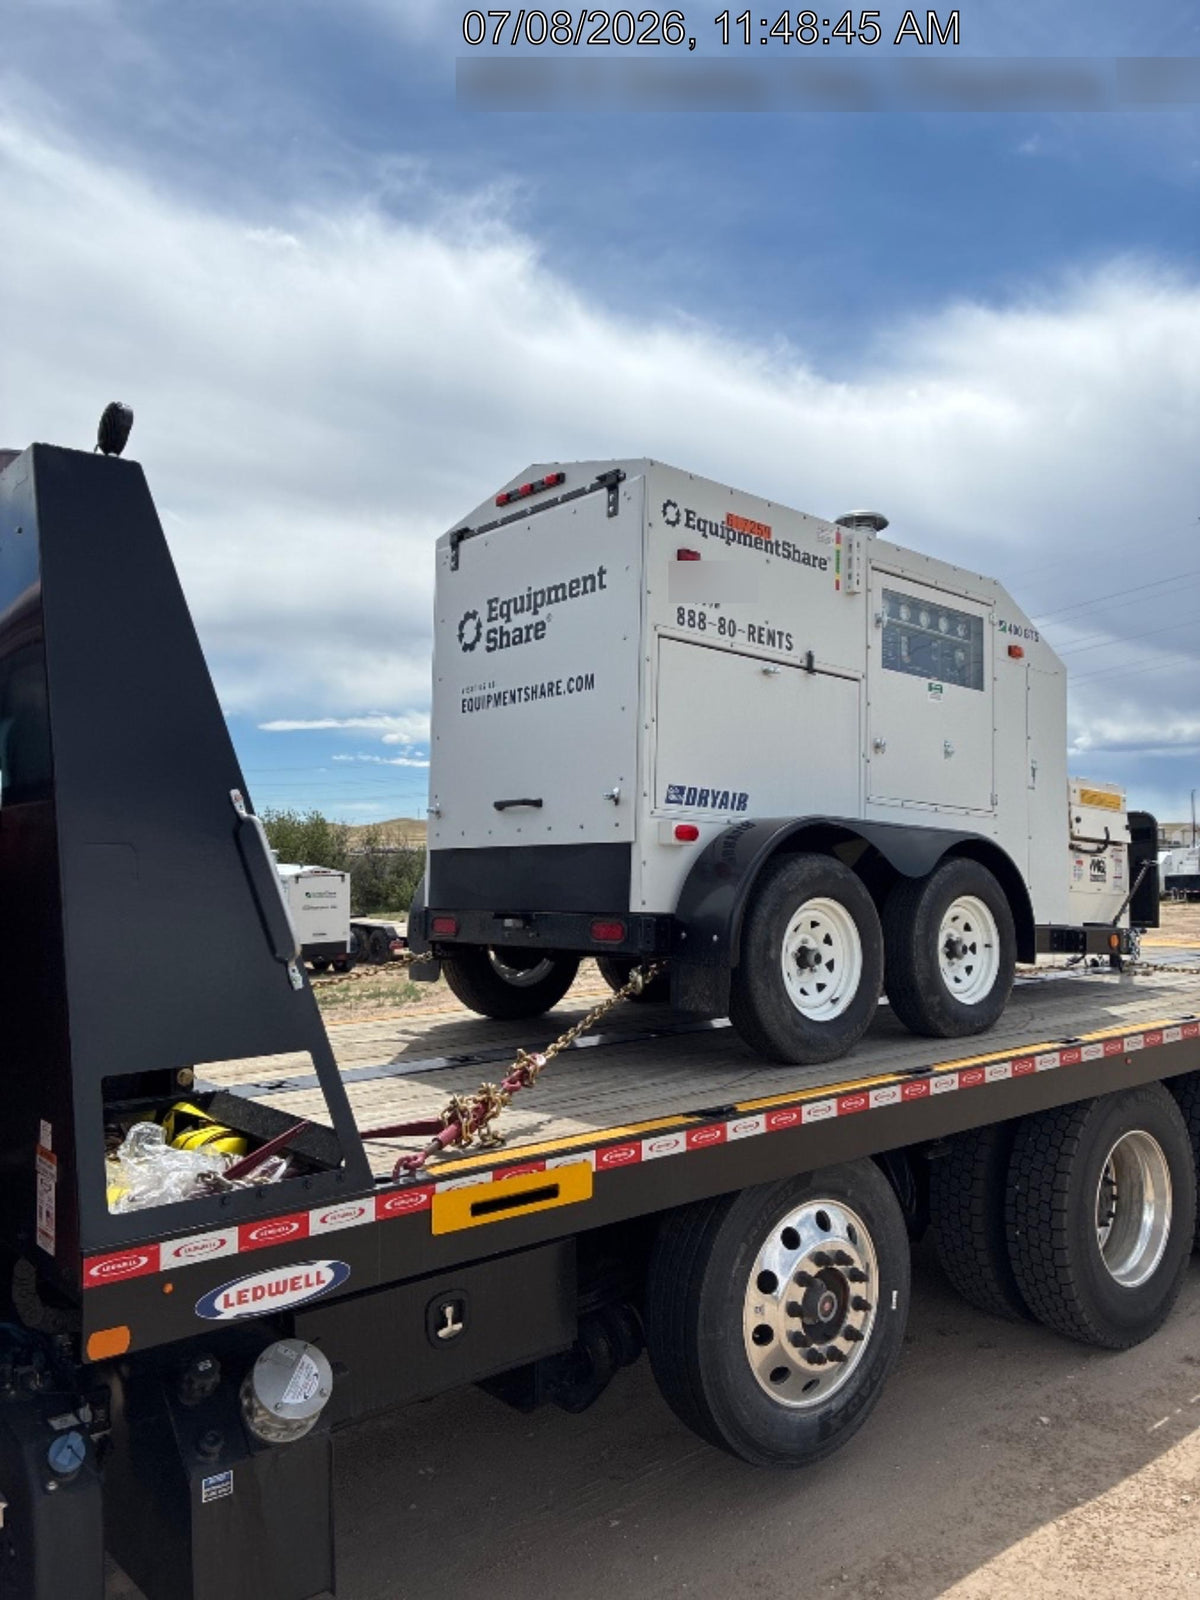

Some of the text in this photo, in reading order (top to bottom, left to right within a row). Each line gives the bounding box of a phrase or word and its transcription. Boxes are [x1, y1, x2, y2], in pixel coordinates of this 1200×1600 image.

[684, 508, 828, 571] EquipmentShare
[486, 564, 607, 625] Equipment
[485, 623, 547, 654] Share
[677, 606, 793, 651] 888-80-RENTS
[461, 673, 595, 713] EQUIPMENTSHARE.COM
[685, 787, 750, 812] DRYAIR
[223, 1271, 326, 1309] LEDWELL
